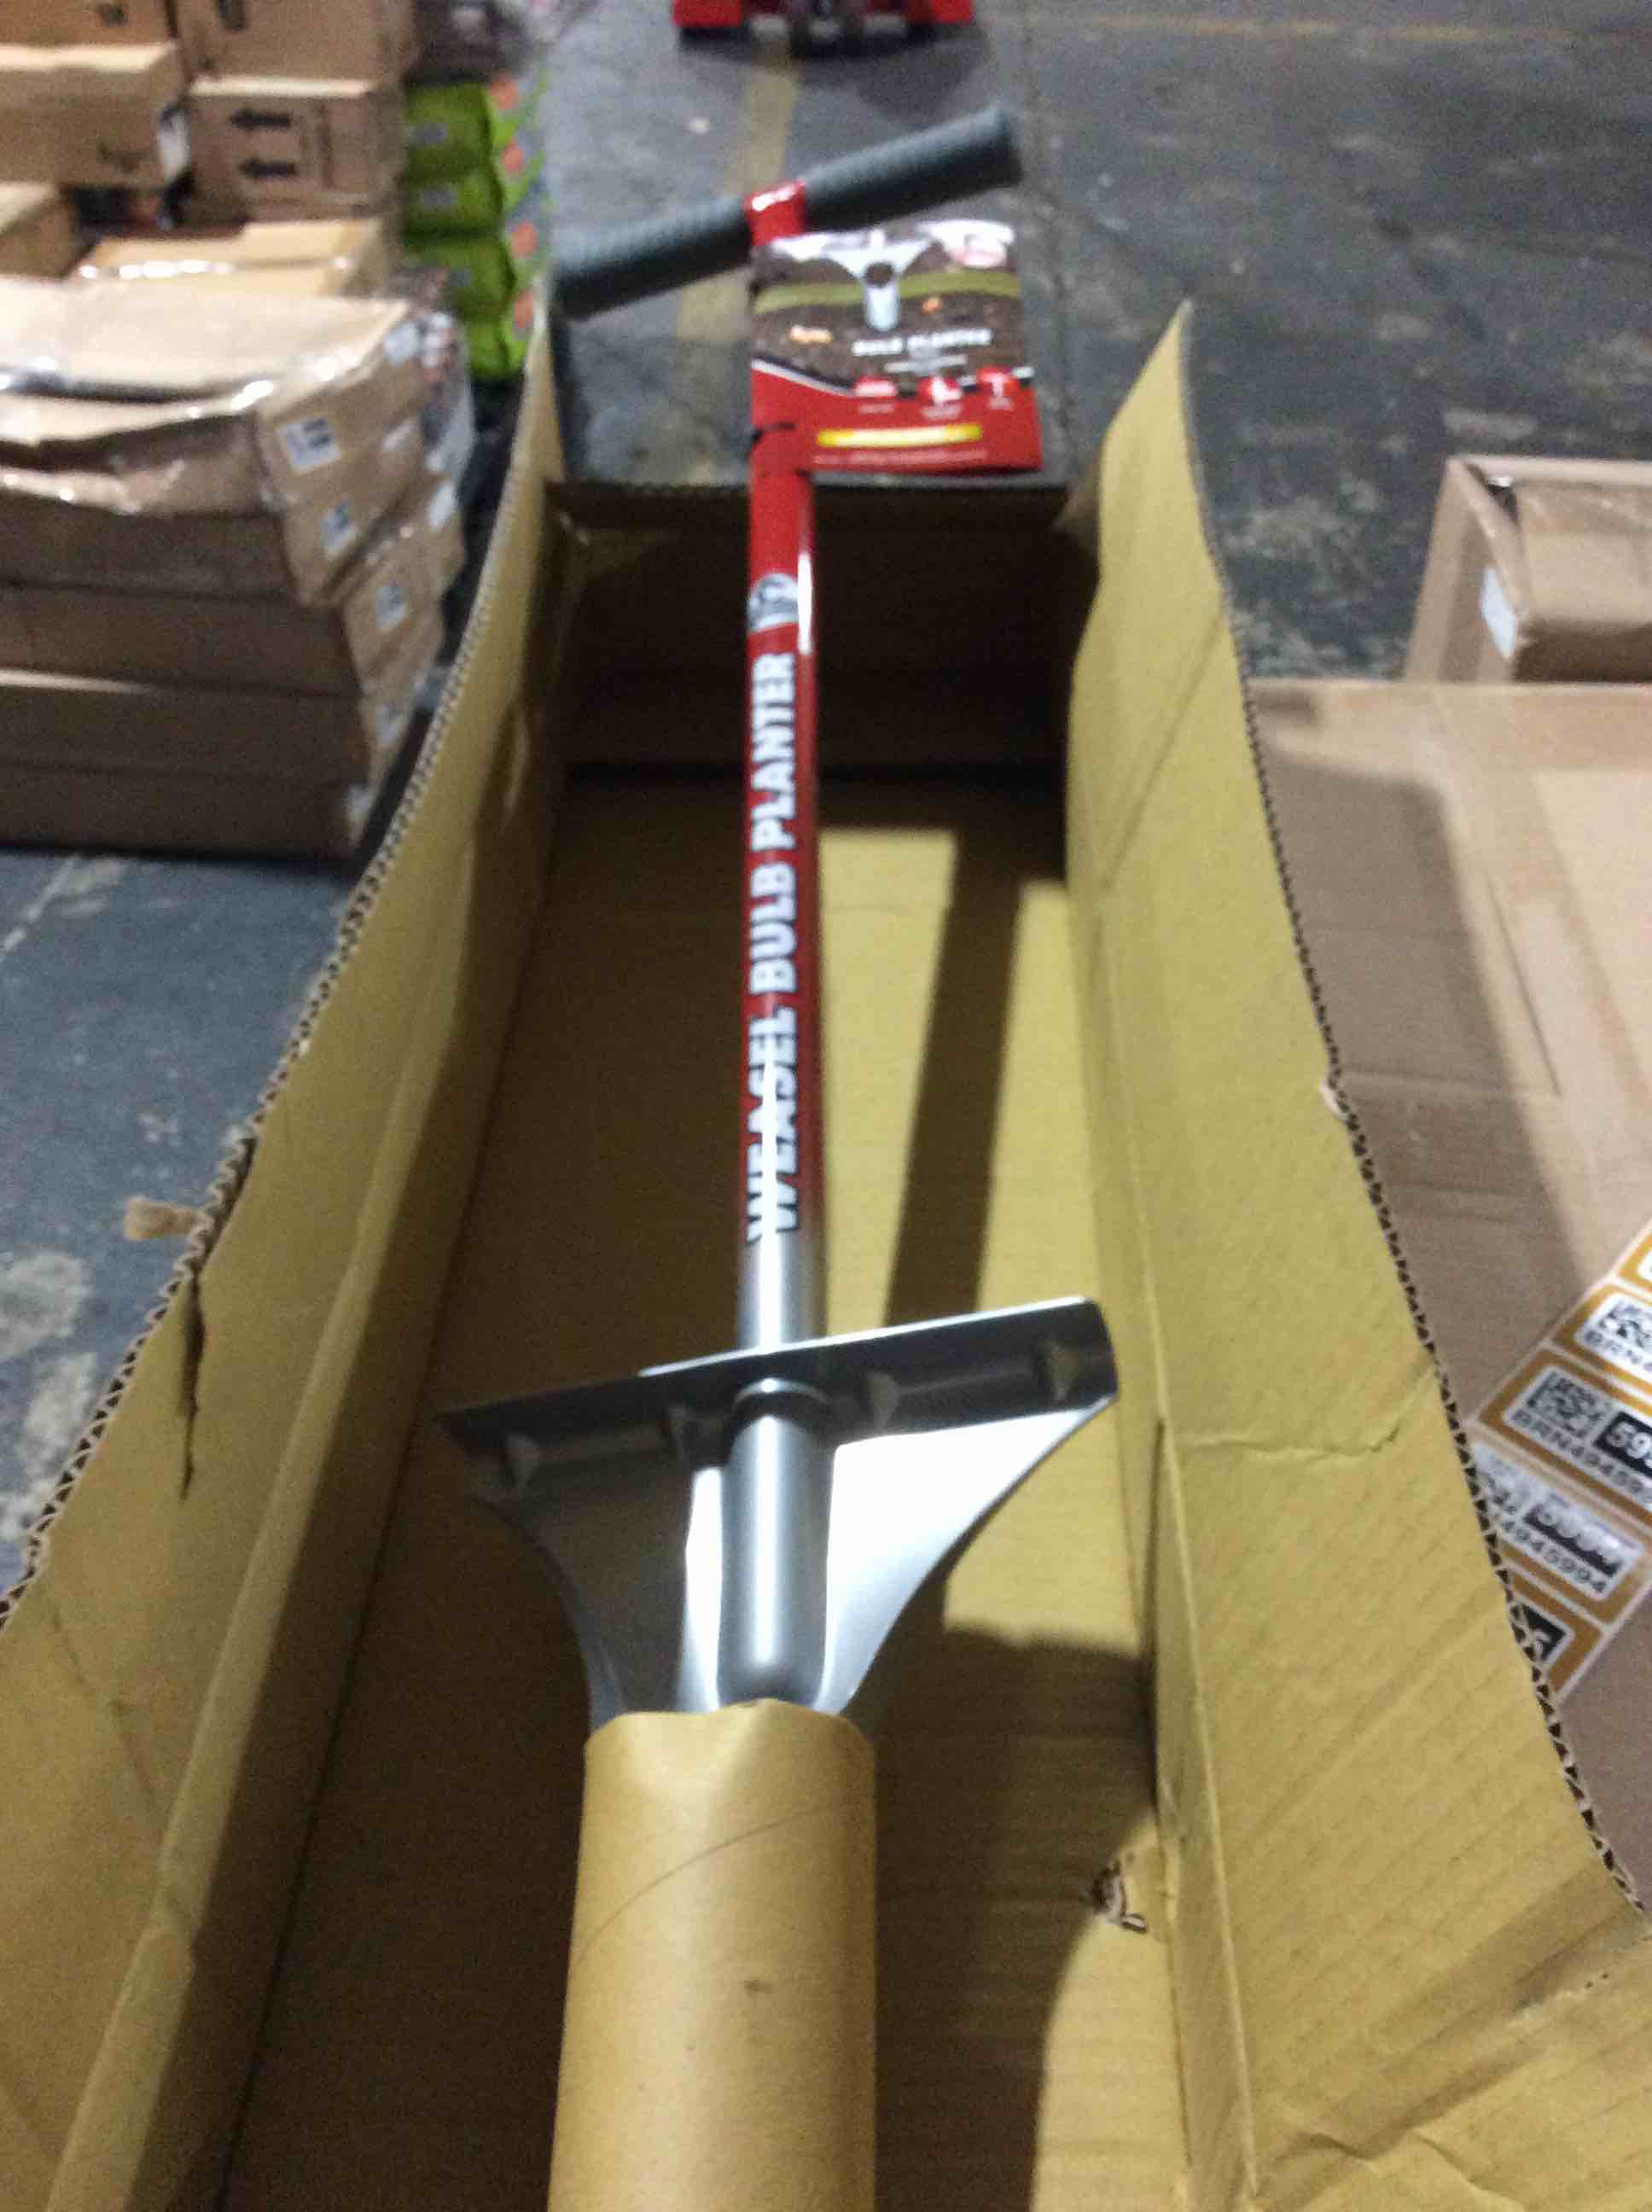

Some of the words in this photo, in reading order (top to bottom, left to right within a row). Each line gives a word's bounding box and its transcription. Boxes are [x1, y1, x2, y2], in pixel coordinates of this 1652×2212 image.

[751, 652, 796, 851] PLANTER
[749, 862, 797, 992] BULB
[747, 1006, 799, 1244] WEASEL
